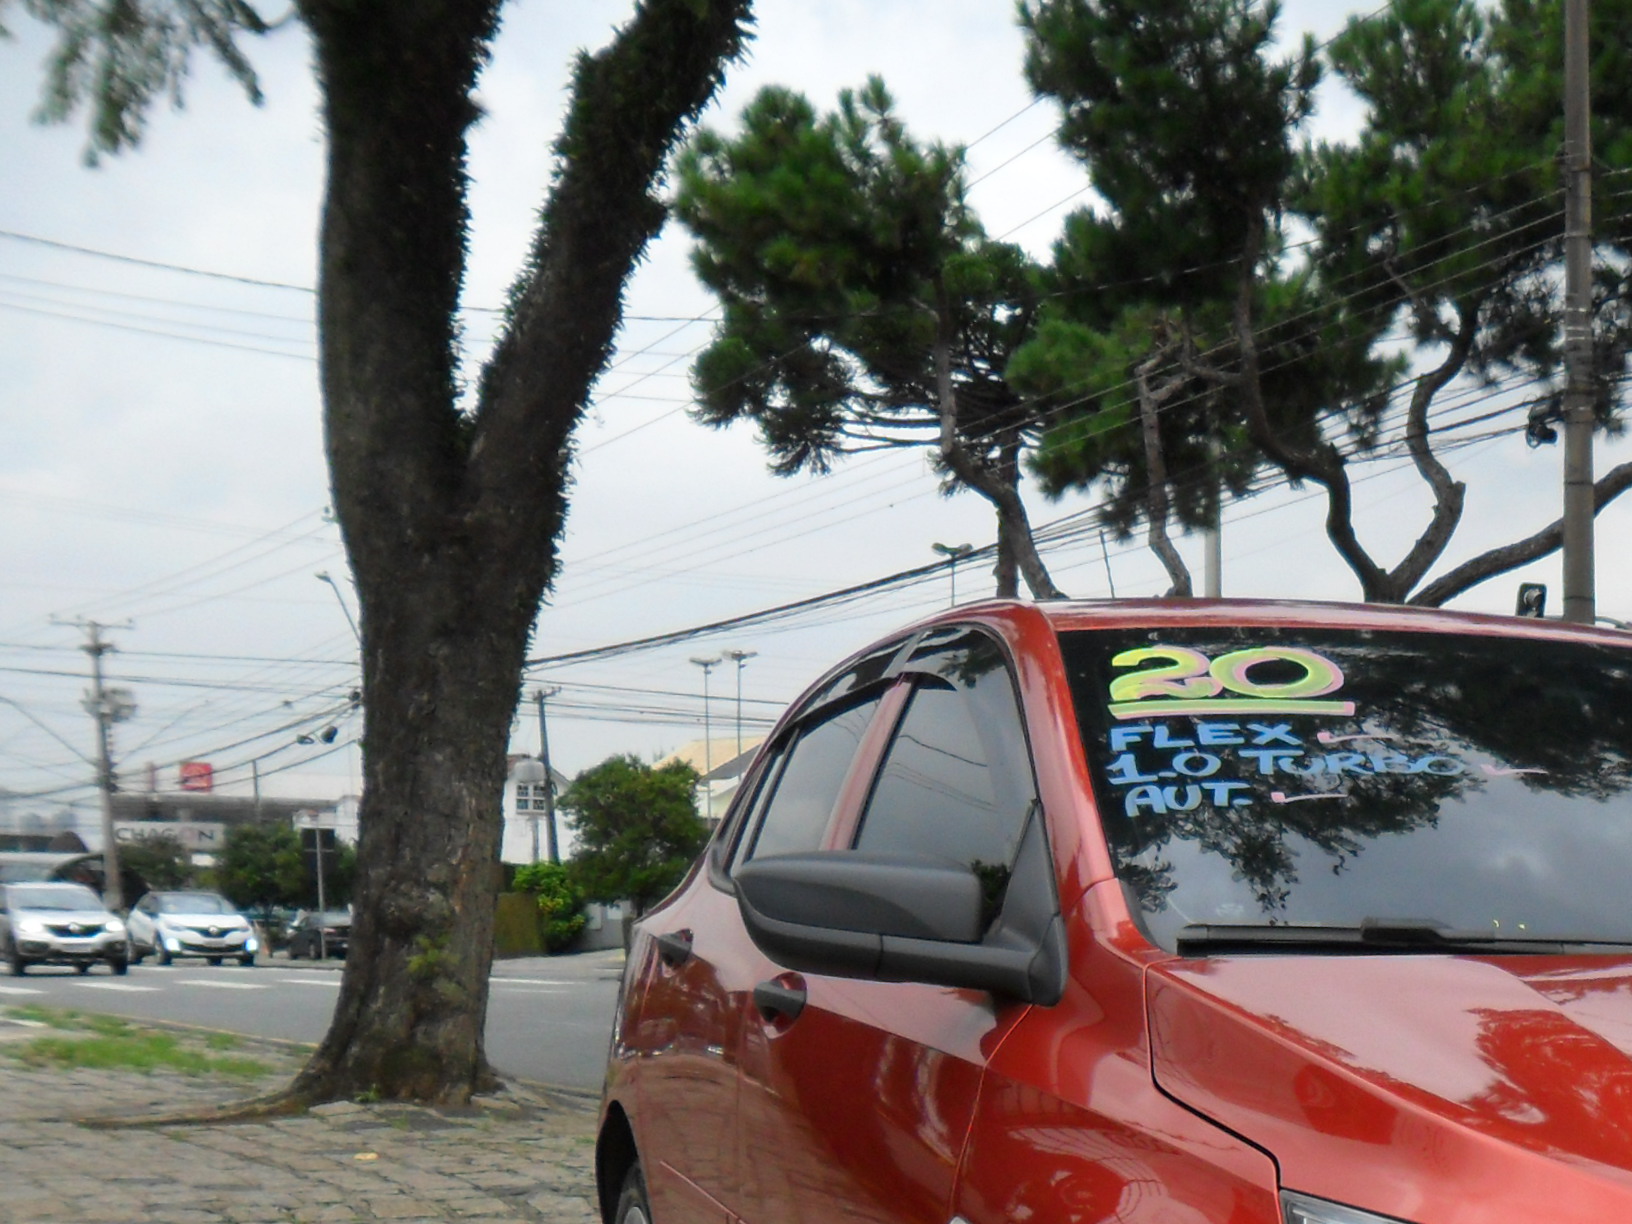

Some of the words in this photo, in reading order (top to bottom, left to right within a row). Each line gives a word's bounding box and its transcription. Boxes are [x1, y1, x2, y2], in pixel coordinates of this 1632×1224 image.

[1109, 644, 1344, 701] 20
[1110, 723, 1302, 751] FLEX
[1105, 751, 1221, 785] 1.0
[1238, 749, 1466, 776] TURBO
[1124, 781, 1253, 818] AUT.
